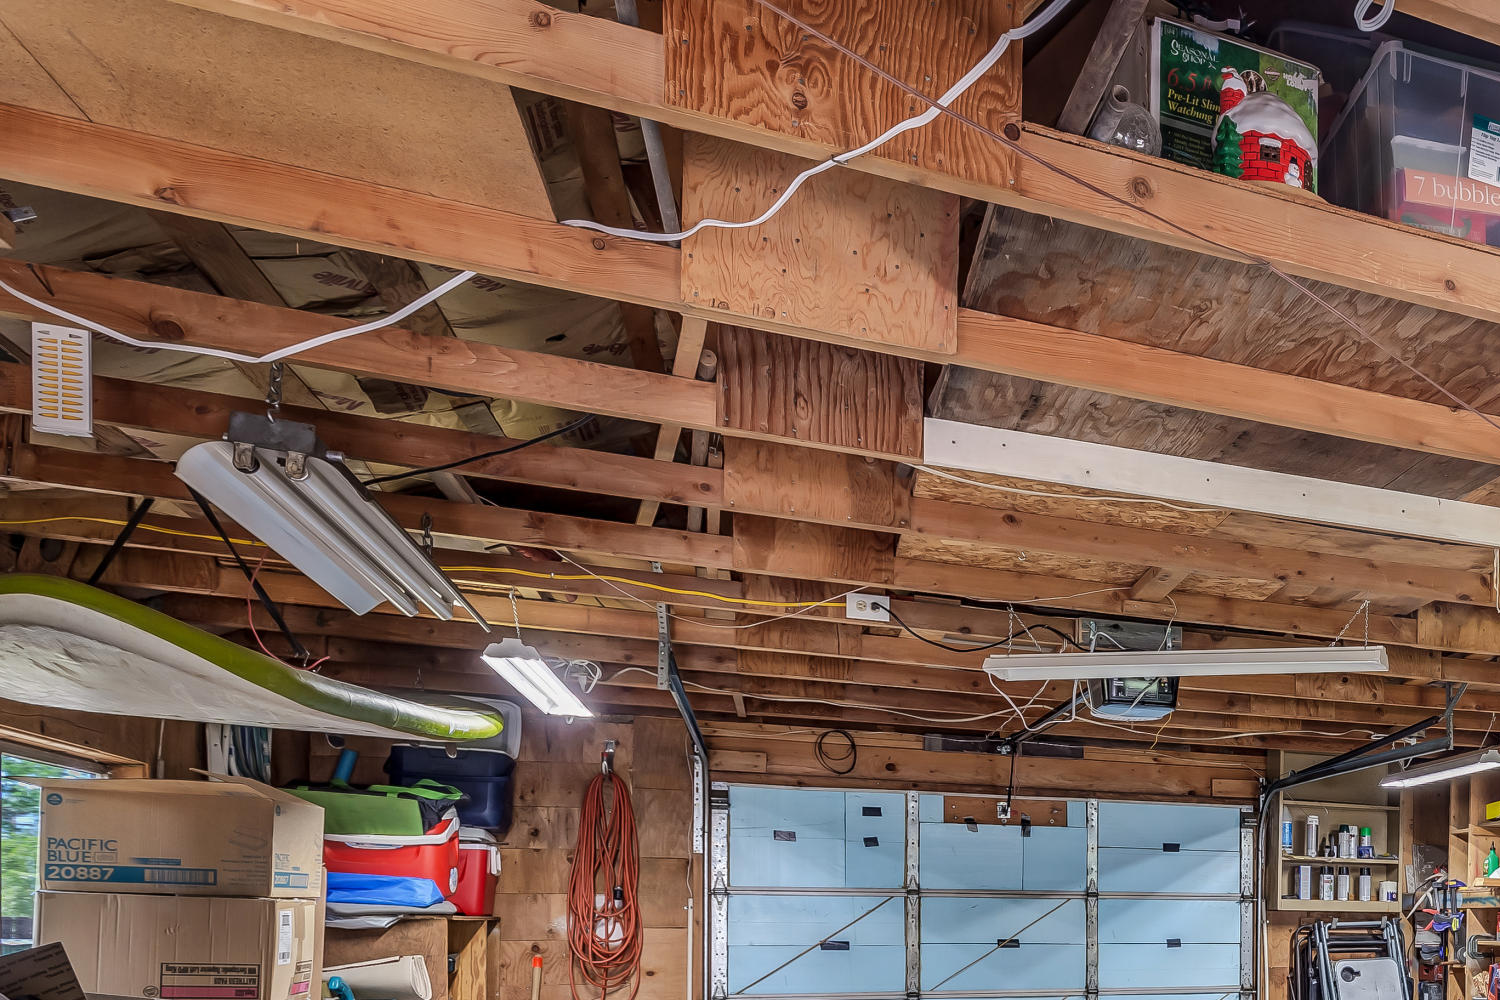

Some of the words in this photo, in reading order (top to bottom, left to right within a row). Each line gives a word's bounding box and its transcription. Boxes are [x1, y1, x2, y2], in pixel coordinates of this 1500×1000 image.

[1167, 87, 1201, 106] Pre-Lit
[1413, 175, 1425, 195] 7
[47, 837, 118, 852] PACIFIC
[47, 850, 92, 864] BLUE
[47, 866, 115, 881] 20887
